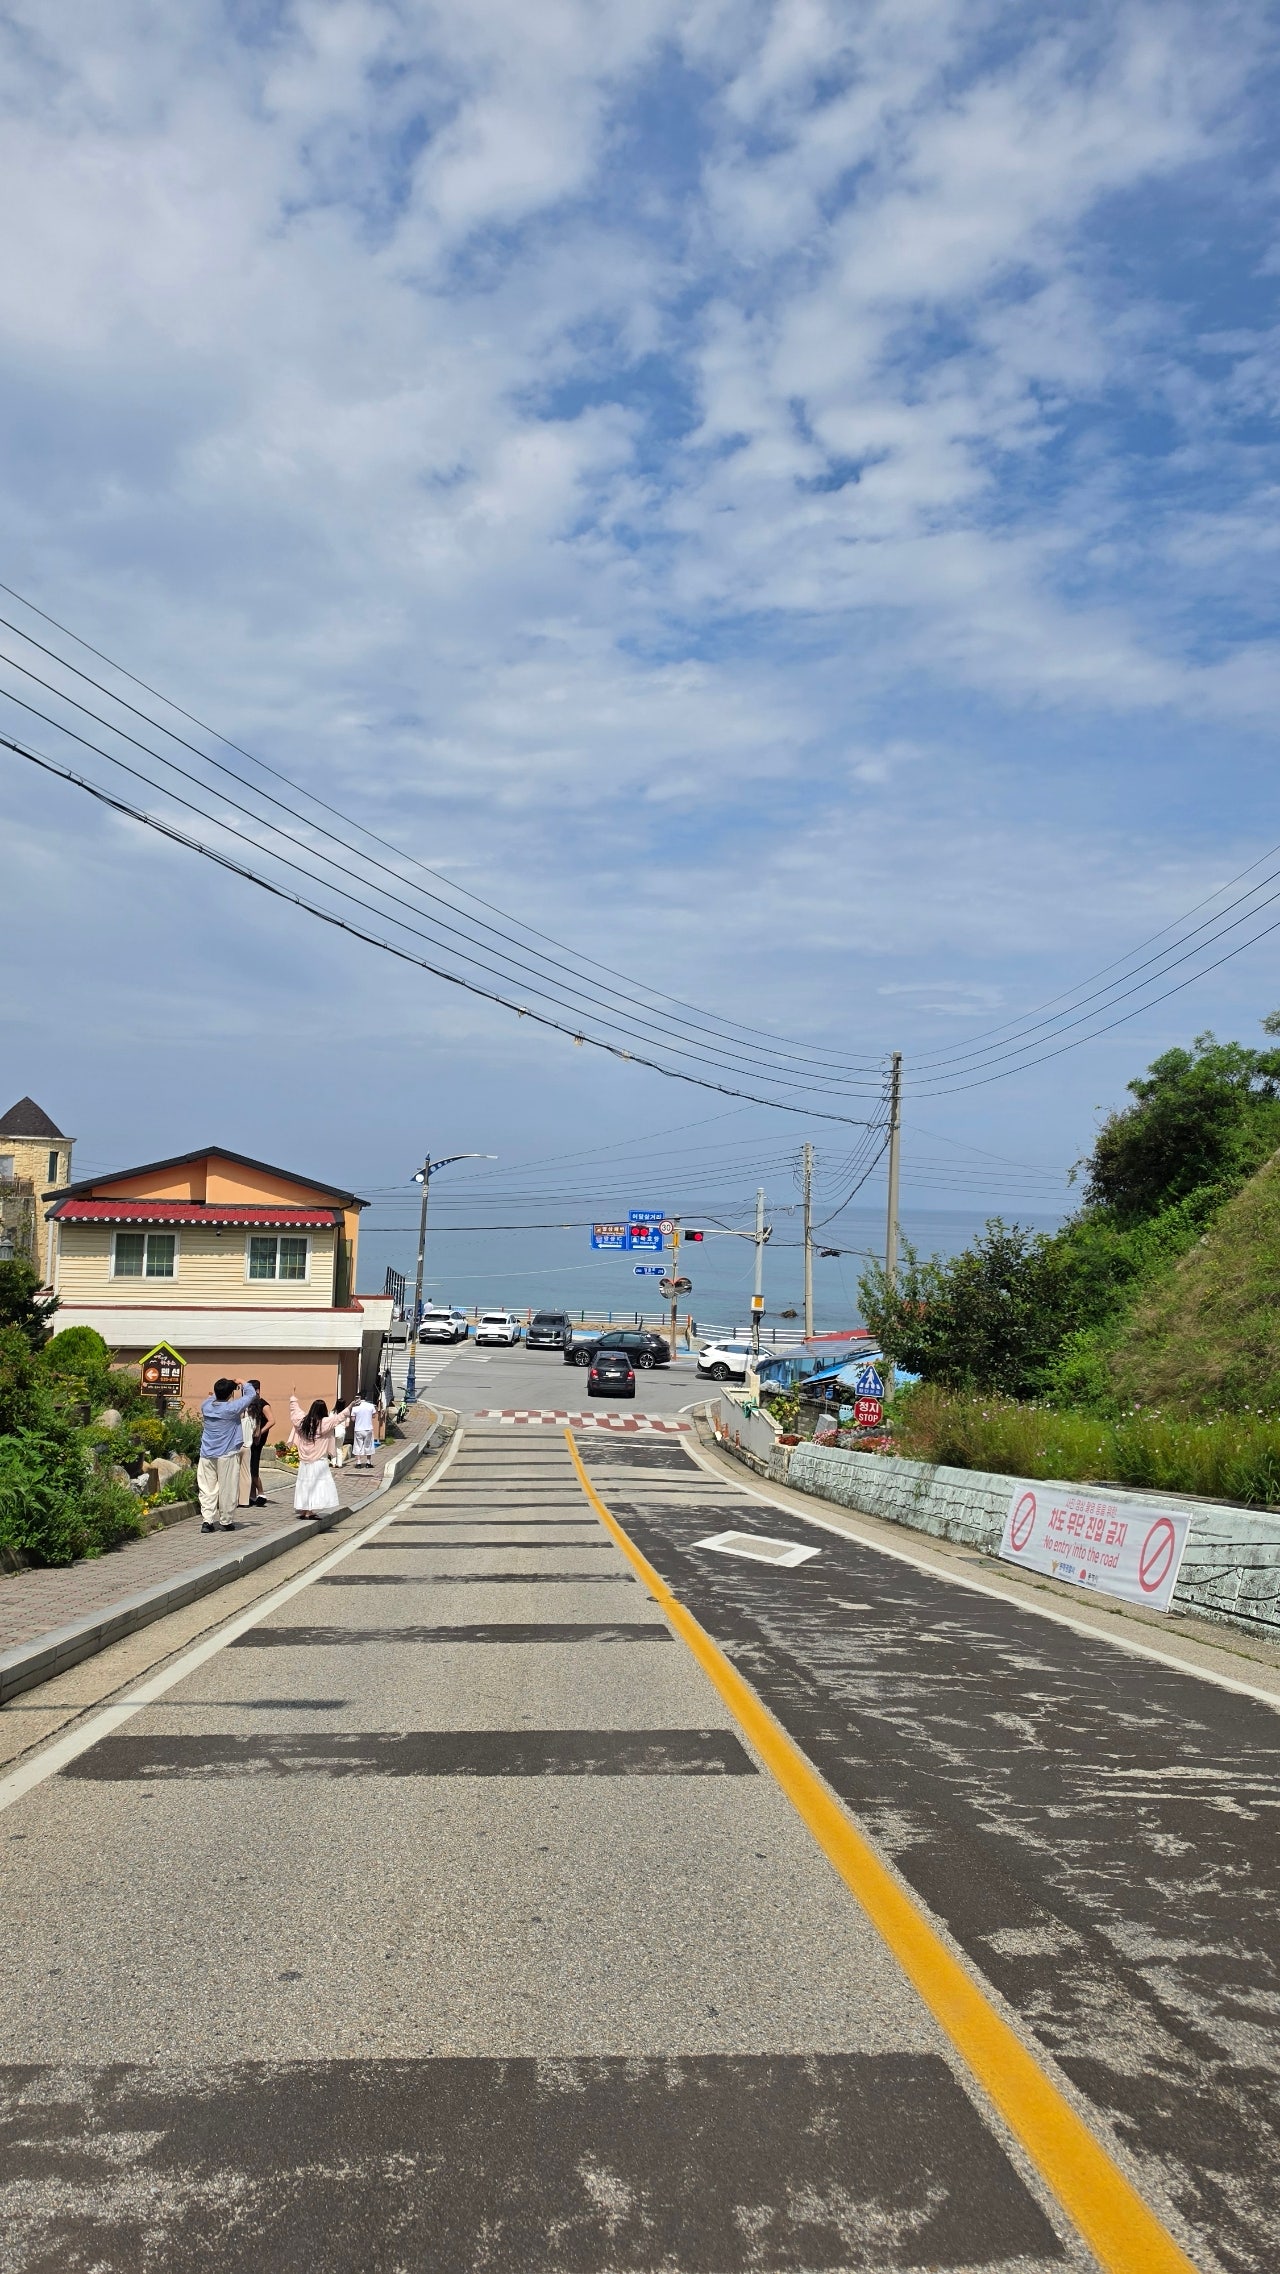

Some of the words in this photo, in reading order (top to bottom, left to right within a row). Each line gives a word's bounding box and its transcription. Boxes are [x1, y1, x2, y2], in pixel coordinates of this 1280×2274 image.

[858, 1413, 879, 1422] STOP
[860, 1401, 879, 1413] 정지
[1048, 1508, 1067, 1531] 차도
[1066, 1513, 1086, 1537] 무단
[1085, 1516, 1107, 1542] 진입
[1105, 1521, 1128, 1547] 금지
[1043, 1535, 1054, 1550] No
[1053, 1540, 1073, 1559] entry
[1072, 1542, 1087, 1560] into
[1087, 1547, 1100, 1563] the
[1100, 1553, 1120, 1568] road
